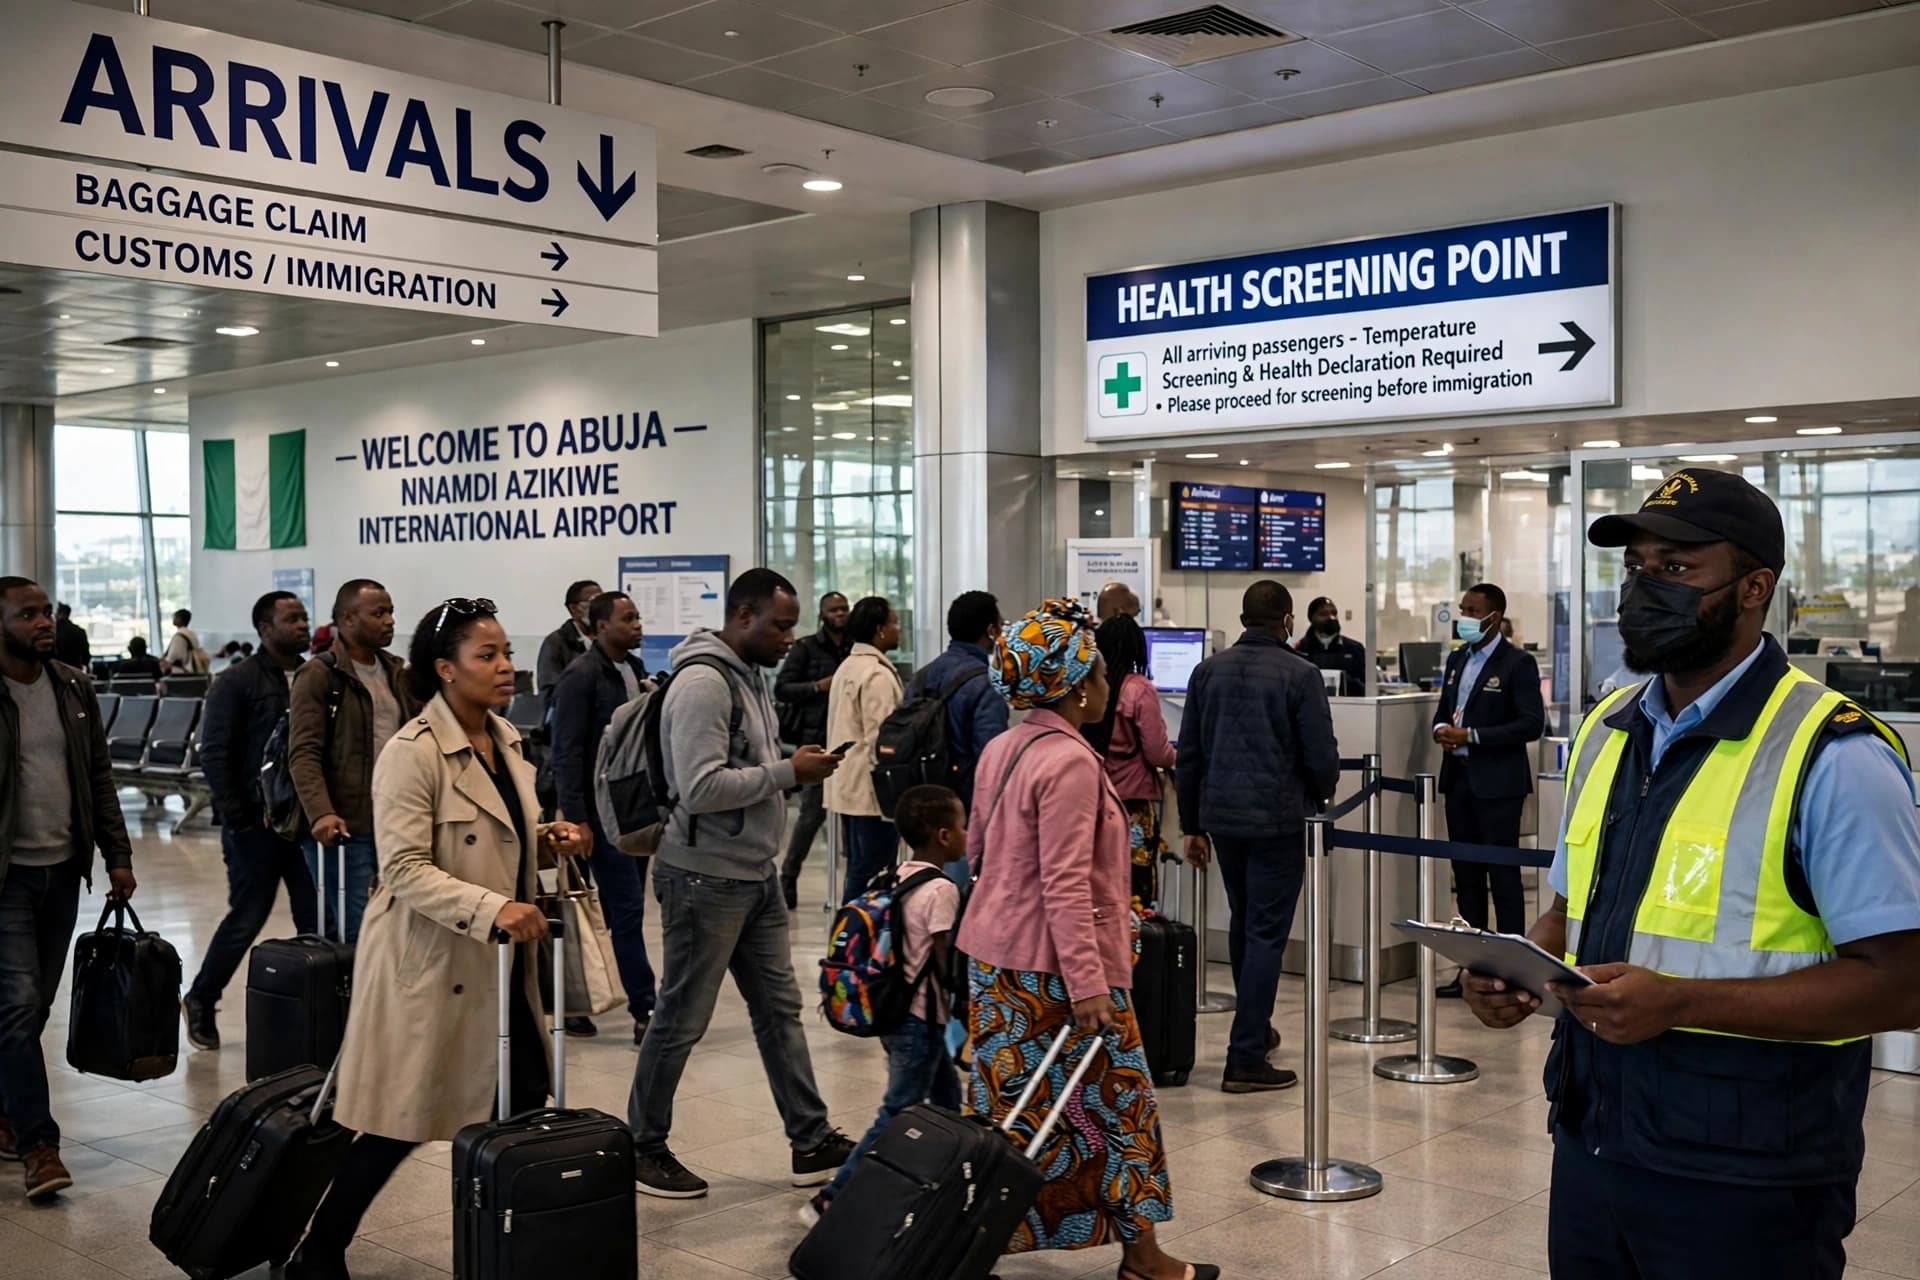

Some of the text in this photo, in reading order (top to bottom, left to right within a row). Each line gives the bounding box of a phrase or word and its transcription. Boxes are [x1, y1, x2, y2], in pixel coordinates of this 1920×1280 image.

[60, 32, 549, 203] ARRIVALS
[76, 173, 366, 243] BAGGAGE CLAIM
[75, 229, 496, 309] CUSTOMS / IMMIGRATION
[1118, 231, 1567, 323] HEALTH SCREENING POINT
[1162, 345, 1182, 364] All
[1187, 341, 1247, 361] arriving
[1252, 334, 1344, 360] passengers
[1363, 320, 1476, 347] Temperature
[1162, 340, 1503, 389] Screening & Health Declaration Required
[1168, 369, 1532, 414] Please proceed for screening before immigration
[362, 426, 500, 470] WELCOME
[507, 422, 548, 459] TO
[557, 410, 667, 456] ABUJA
[402, 463, 619, 506] NNAMDI AZIKIWE
[359, 501, 677, 545] INTERNATIONAL AIRPORT
